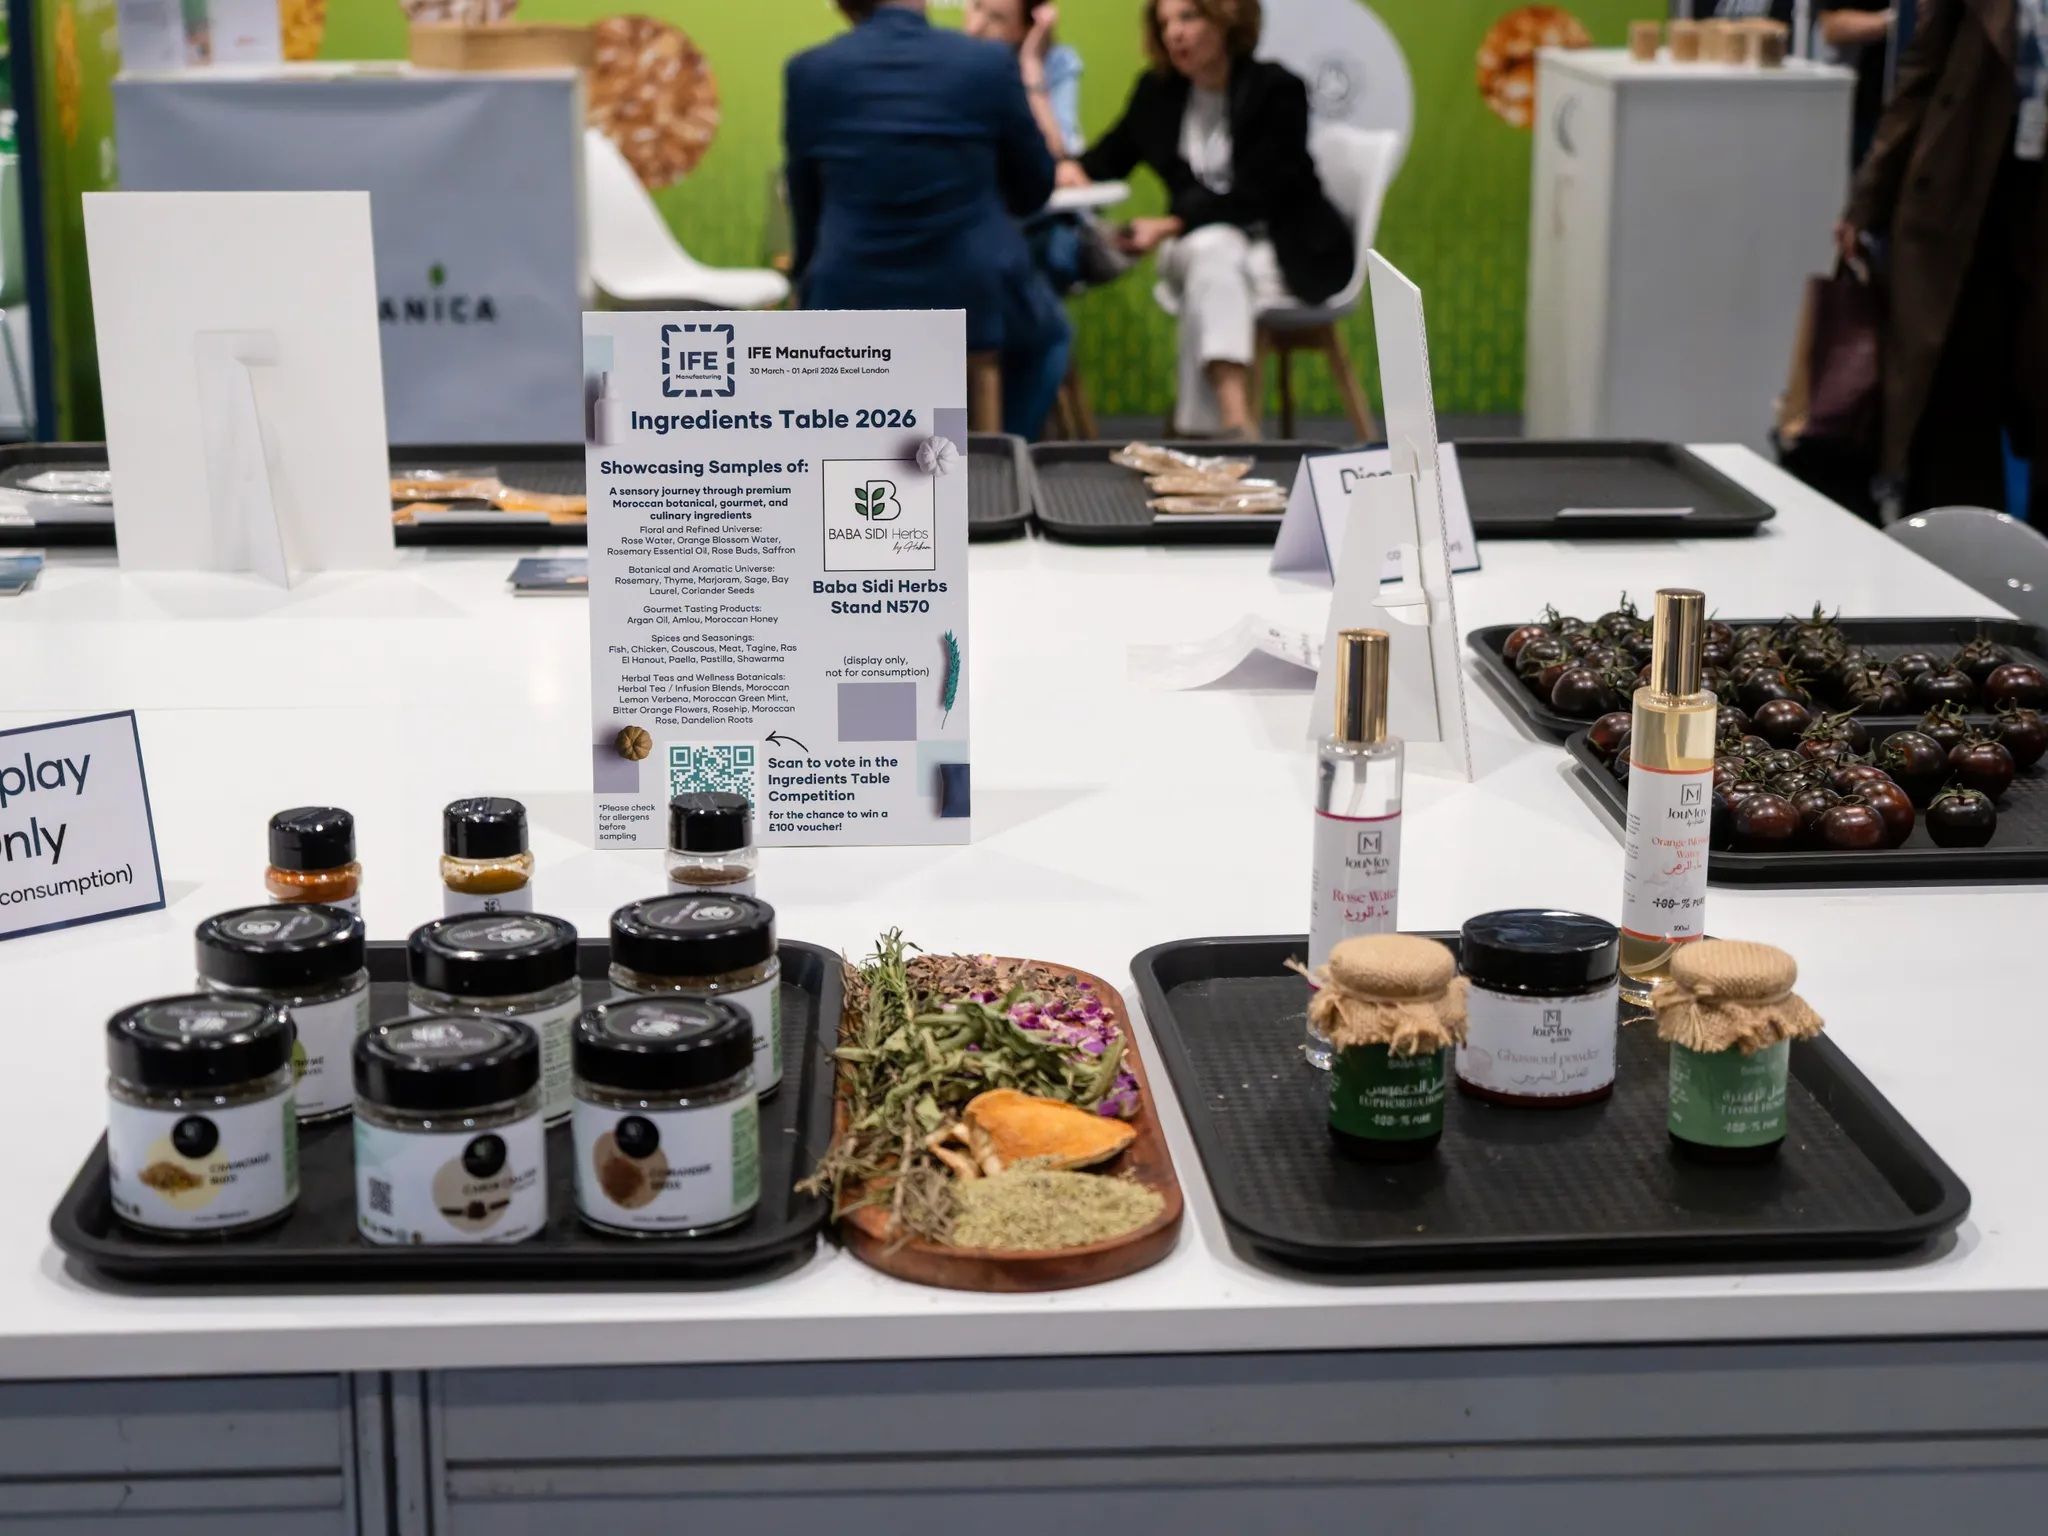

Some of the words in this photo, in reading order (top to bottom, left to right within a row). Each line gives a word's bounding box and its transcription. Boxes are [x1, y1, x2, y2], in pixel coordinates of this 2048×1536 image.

[748, 347, 771, 359] IFE
[776, 346, 891, 361] Manufacturing
[680, 352, 718, 370] IFE
[632, 409, 772, 435] Ingredients
[779, 409, 849, 428] Table
[856, 409, 916, 428] 2026
[601, 460, 704, 477] Showcasing
[709, 460, 782, 476] Samples
[787, 459, 808, 473] of:
[609, 487, 617, 495] A
[620, 489, 659, 497] sensory
[661, 486, 700, 497] journey
[703, 486, 743, 496] through
[746, 486, 791, 496] premium
[613, 500, 663, 508] Moroccan
[666, 498, 717, 508] botanical,
[720, 499, 766, 509] gourmet,
[768, 498, 788, 506] and
[650, 511, 691, 521] culinary
[694, 511, 752, 522] ingredients
[640, 526, 664, 534] Floral
[722, 525, 762, 533] Universe:
[829, 528, 862, 540] BABA
[865, 528, 887, 540] SIDI
[892, 528, 928, 539] Herbs
[645, 537, 675, 545] Water,
[677, 536, 710, 545] Orange
[712, 536, 749, 544] Blossom
[751, 536, 780, 544] Water,
[607, 548, 652, 556] Rosemary
[654, 547, 693, 555] Essential
[695, 547, 710, 555] Oil,
[736, 546, 760, 554] Buds,
[762, 546, 795, 554] Saffron
[692, 565, 733, 573] Aromatic
[615, 577, 661, 585] Rosemary,
[664, 576, 696, 585] Thyme,
[698, 576, 742, 585] Marjoram,
[744, 576, 769, 585] Sage,
[772, 575, 789, 584] Bay
[650, 587, 679, 595] Laurel,
[728, 586, 754, 594] Seeds
[813, 580, 856, 593] Baba
[862, 579, 893, 593] Sidi
[898, 579, 947, 592] Herbs
[684, 605, 718, 614] Tasting
[831, 600, 881, 614] Stand
[887, 600, 929, 613] N570
[627, 617, 654, 626] Argan
[656, 616, 670, 624] Oil,
[672, 616, 702, 624] Amlou,
[750, 616, 778, 624] Honey
[652, 634, 680, 643] Spices
[682, 634, 700, 642] and
[702, 634, 754, 643] Seasonings:
[609, 646, 629, 654] Fish,
[631, 643, 669, 653] Chicken,
[671, 645, 716, 653] Couscous,
[746, 644, 778, 654] Tagine,
[622, 656, 630, 664] El
[632, 656, 666, 664] Hanout,
[669, 656, 698, 664] Paella,
[700, 655, 735, 664] Pastilla,
[844, 656, 882, 666] (display
[885, 656, 908, 666] only,
[826, 669, 842, 677] not
[845, 668, 859, 676] for
[861, 667, 929, 678] consumption)
[622, 674, 650, 683] Herbal
[653, 674, 674, 682] Teas
[736, 673, 785, 681] Botanicals:
[675, 684, 710, 692] Infusion
[712, 683, 744, 692] Blends,
[738, 694, 765, 702] Green
[767, 694, 788, 702] Mint,
[613, 706, 637, 714] Bitter
[640, 706, 672, 715] Orange
[675, 706, 710, 714] Flowers,
[712, 705, 749, 715] Rosehip,
[682, 716, 726, 724] Dandelion
[768, 758, 803, 768] Scan
[806, 758, 821, 768] to
[824, 758, 855, 768] vote
[860, 756, 871, 767] in
[875, 756, 898, 767] the
[0, 752, 91, 808] play
[768, 774, 847, 787] Ingredients
[850, 772, 890, 784] Table
[768, 790, 854, 804] Competition
[612, 812, 650, 822] allergens
[768, 810, 784, 819] for
[786, 811, 804, 819] the
[806, 810, 844, 818] chance
[847, 810, 858, 818] to
[860, 809, 878, 818] win
[769, 823, 794, 831] £100
[796, 823, 842, 831] voucher!
[0, 817, 67, 865] nly
[600, 833, 636, 841] sampling
[1652, 836, 1685, 849] Orange
[0, 864, 133, 906] consumption)
[1332, 889, 1365, 903] Rose
